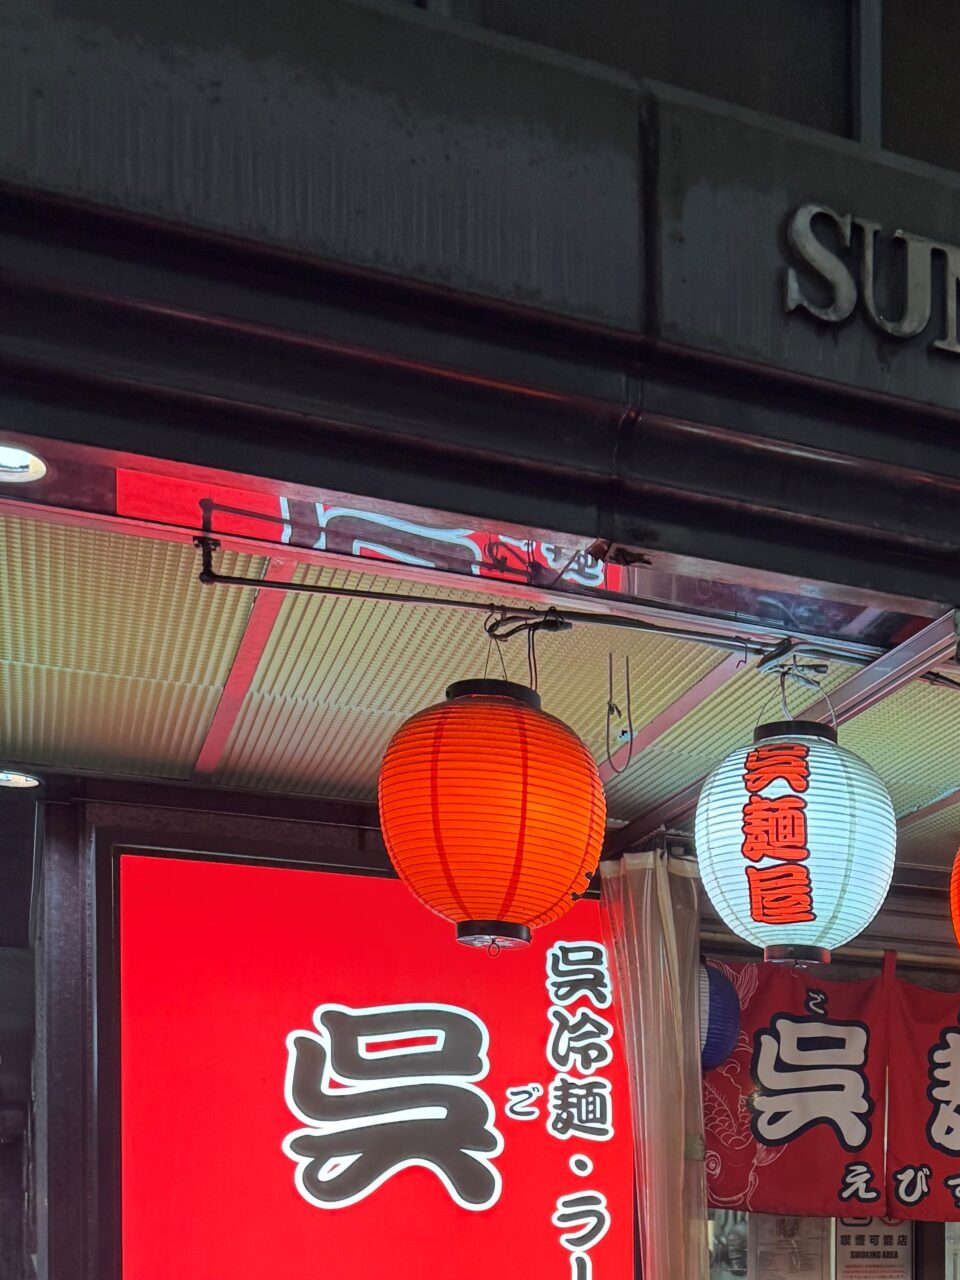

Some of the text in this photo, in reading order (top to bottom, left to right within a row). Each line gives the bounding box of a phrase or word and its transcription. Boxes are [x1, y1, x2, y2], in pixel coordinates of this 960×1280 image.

[741, 743, 817, 926] 呉麺屋
[505, 1083, 544, 1120] ご
